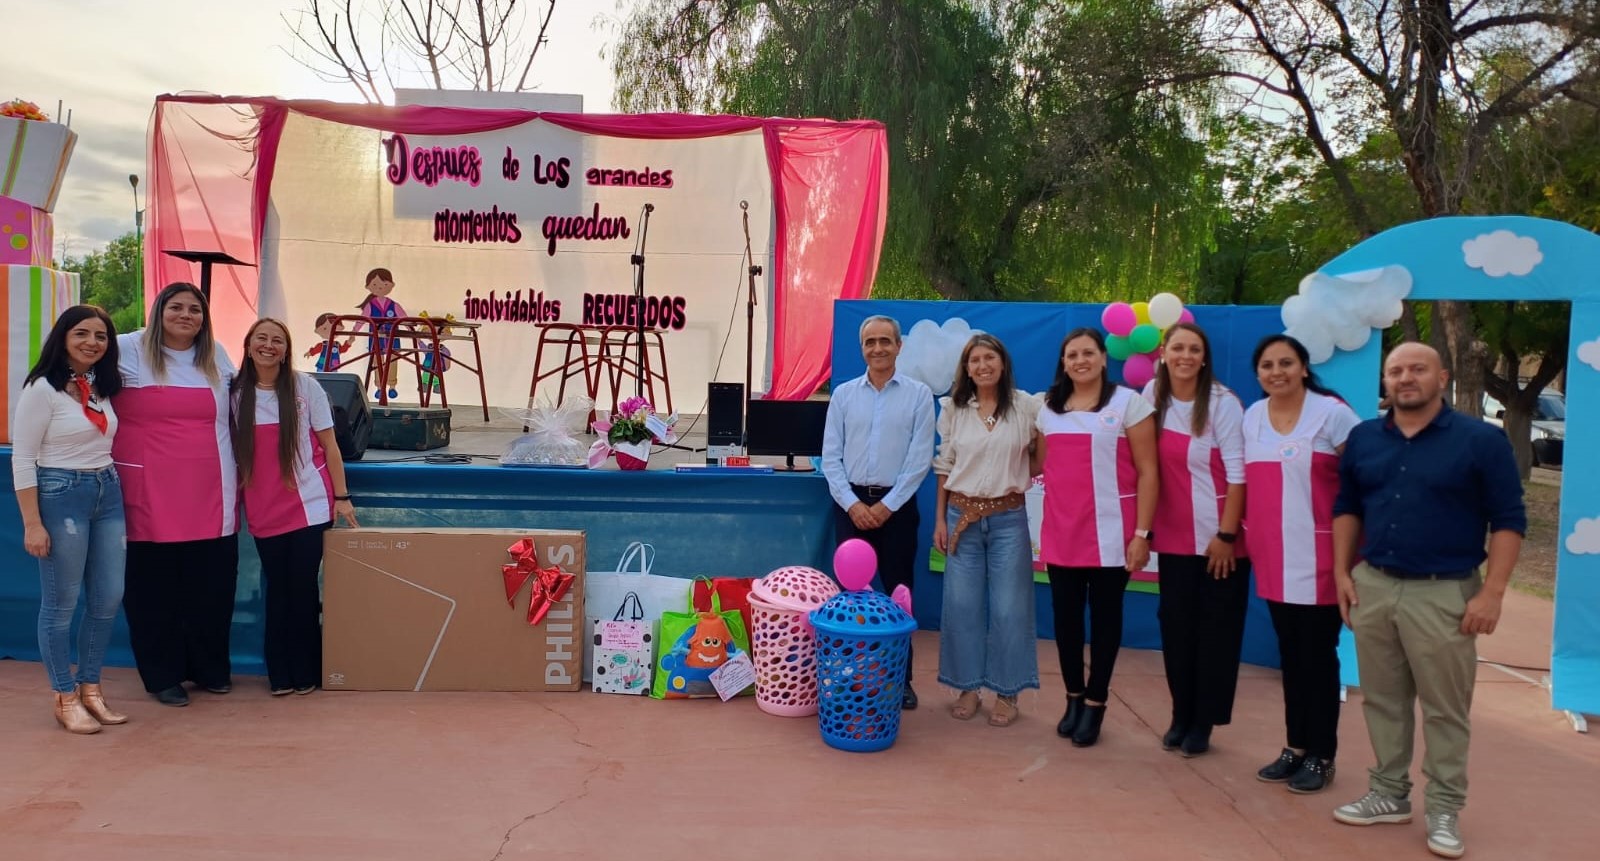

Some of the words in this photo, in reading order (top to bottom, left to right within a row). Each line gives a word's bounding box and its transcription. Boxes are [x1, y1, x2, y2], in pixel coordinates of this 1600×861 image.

[382, 134, 482, 187] Despues
[502, 145, 520, 181] de
[585, 165, 673, 188] grandes
[434, 204, 522, 244] momentos
[542, 202, 630, 256] quedan
[464, 288, 561, 323] inolvidables
[545, 544, 575, 685] PHILS
